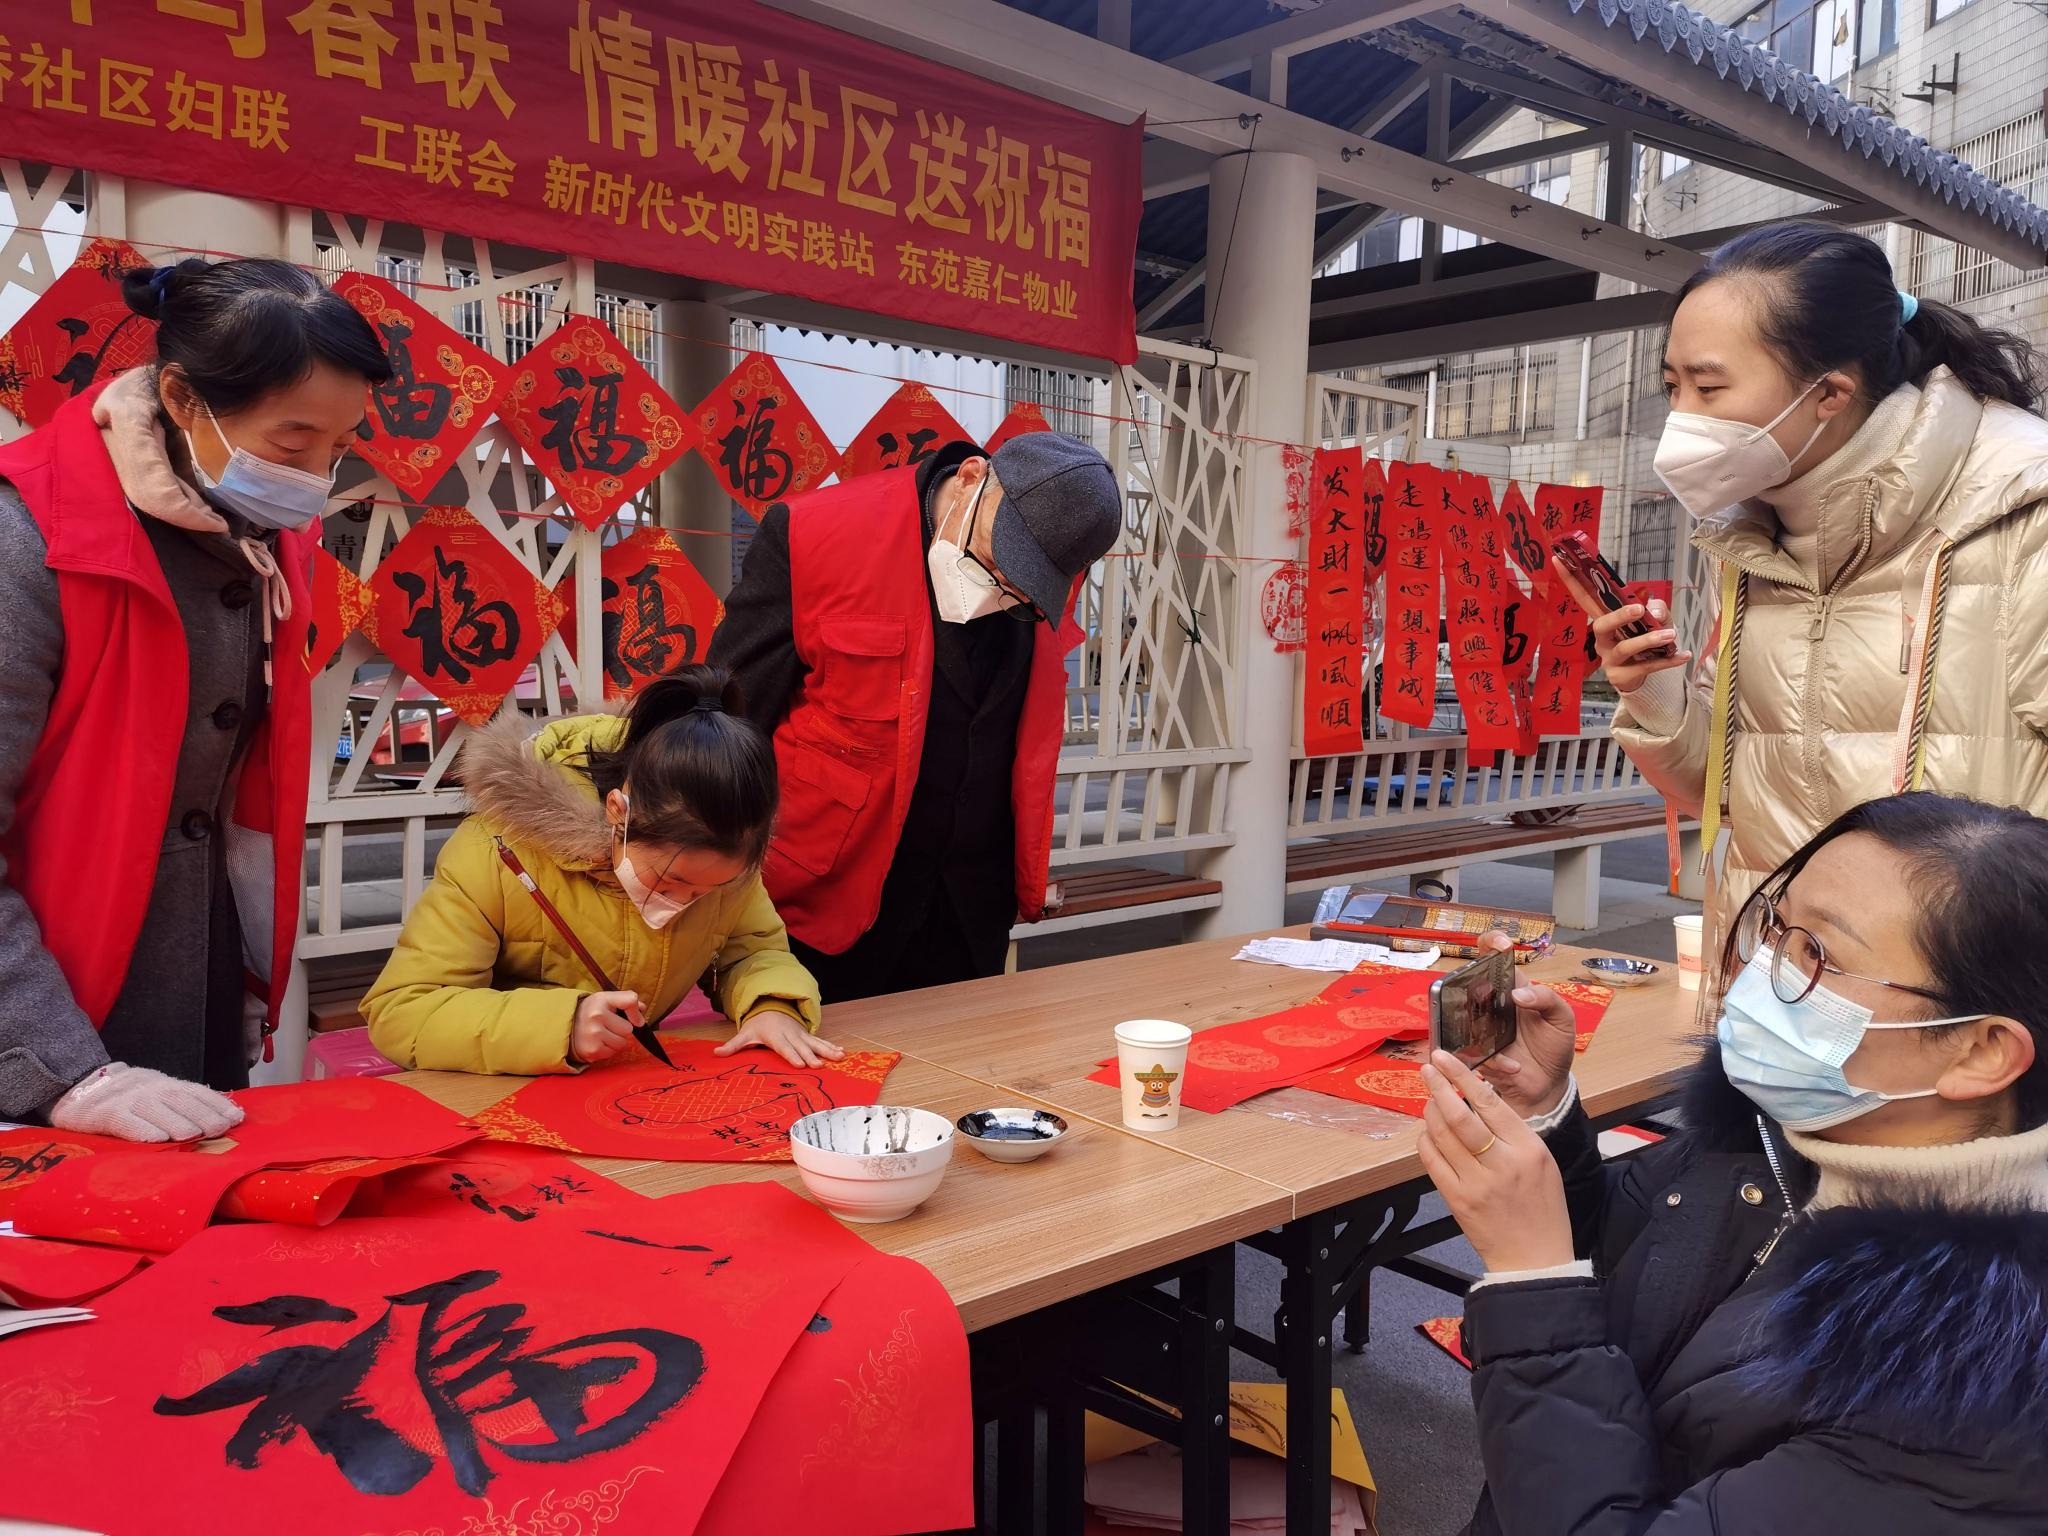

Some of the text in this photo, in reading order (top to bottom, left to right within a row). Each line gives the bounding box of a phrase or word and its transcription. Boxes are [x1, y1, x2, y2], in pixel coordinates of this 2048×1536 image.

[568, 0, 1092, 268] 情暖社区送祝福
[354, 115, 517, 197] 工联会
[542, 155, 875, 277] 新时代文明实践站
[896, 240, 1078, 320] 东苑嘉仁物业
[538, 367, 648, 477] 福
[717, 397, 793, 501] 福
[1507, 505, 1545, 574] 福
[392, 545, 520, 685] 福
[152, 1268, 707, 1498] 福
